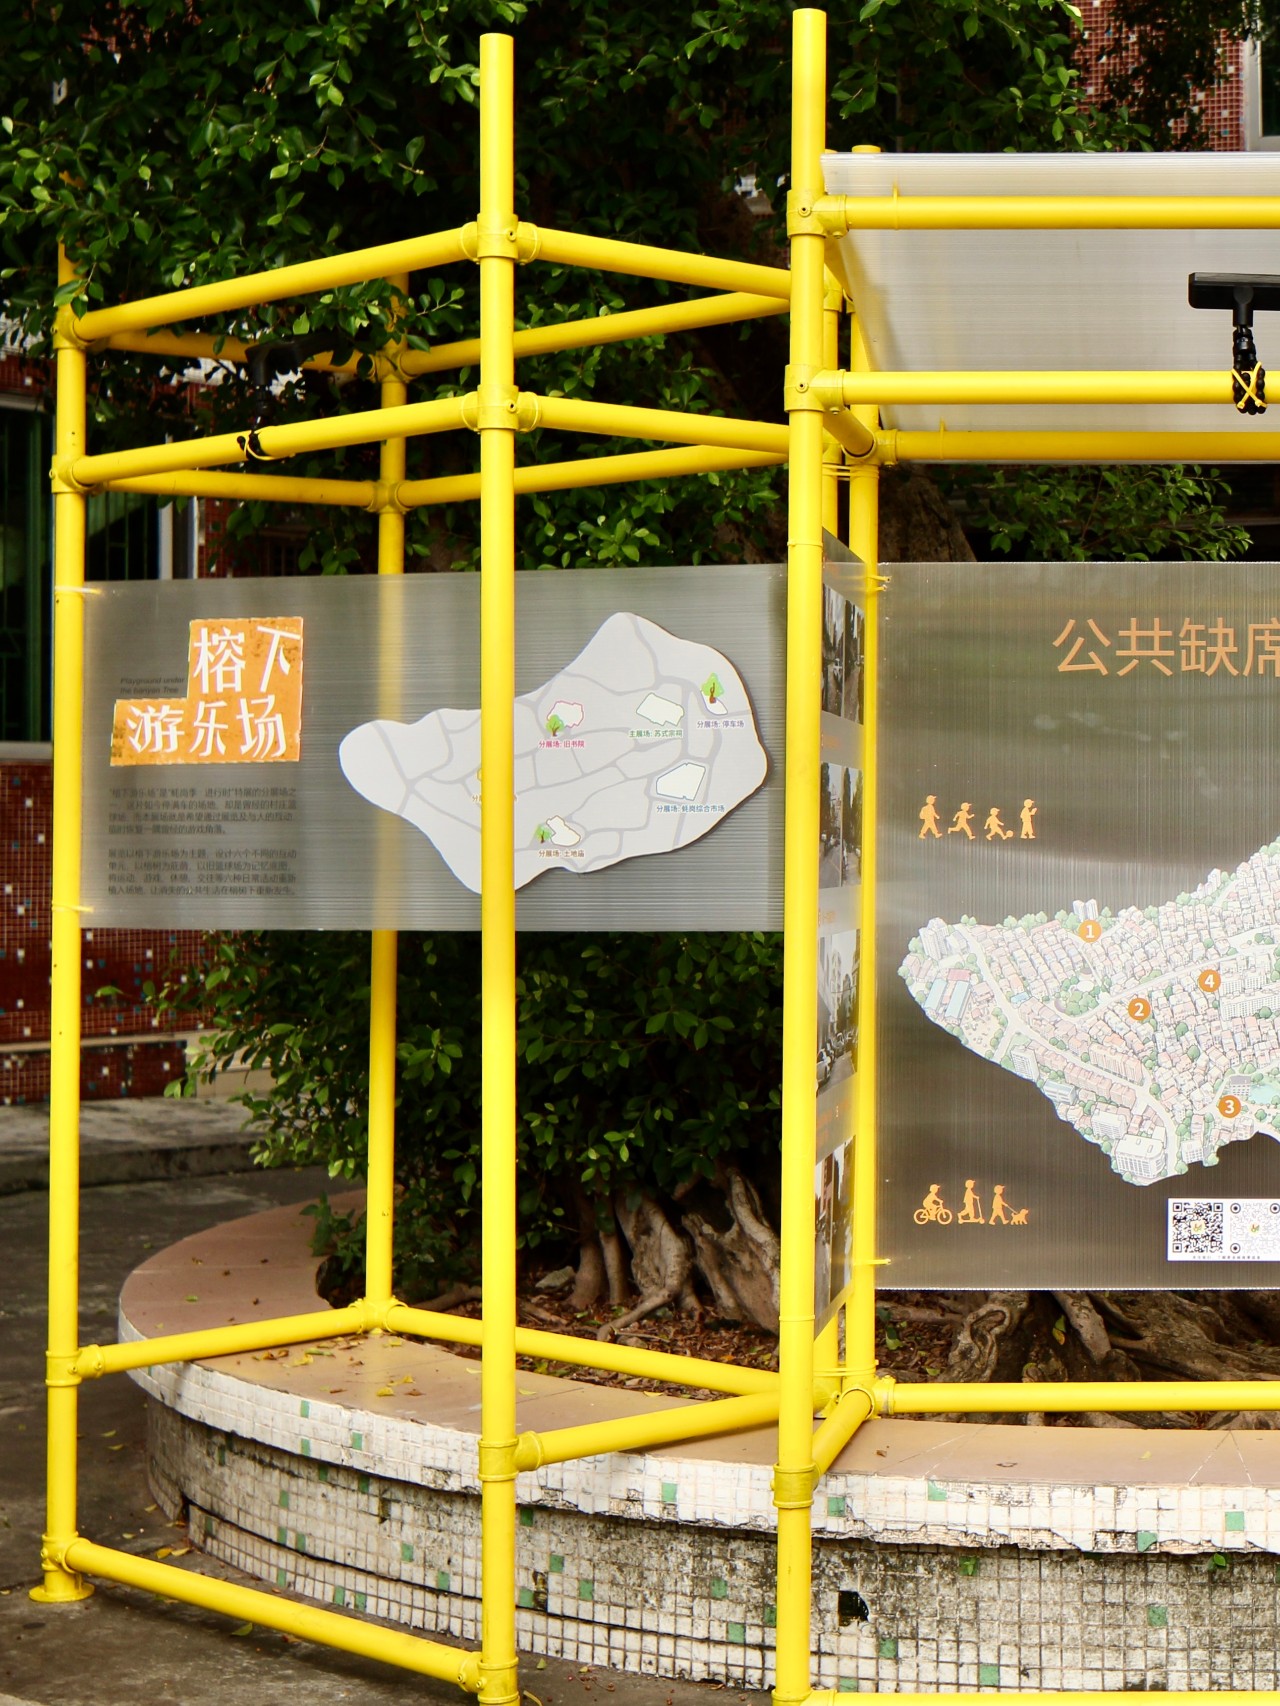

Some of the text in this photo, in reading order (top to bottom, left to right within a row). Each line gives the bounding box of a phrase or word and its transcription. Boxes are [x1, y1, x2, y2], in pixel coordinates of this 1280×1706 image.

[193, 625, 301, 694] 榕下
[126, 694, 287, 759] 游乐场
[1086, 924, 1095, 938] 1
[1205, 974, 1215, 988] 4
[1135, 1002, 1144, 1016] 2
[1225, 1099, 1235, 1114] 3
